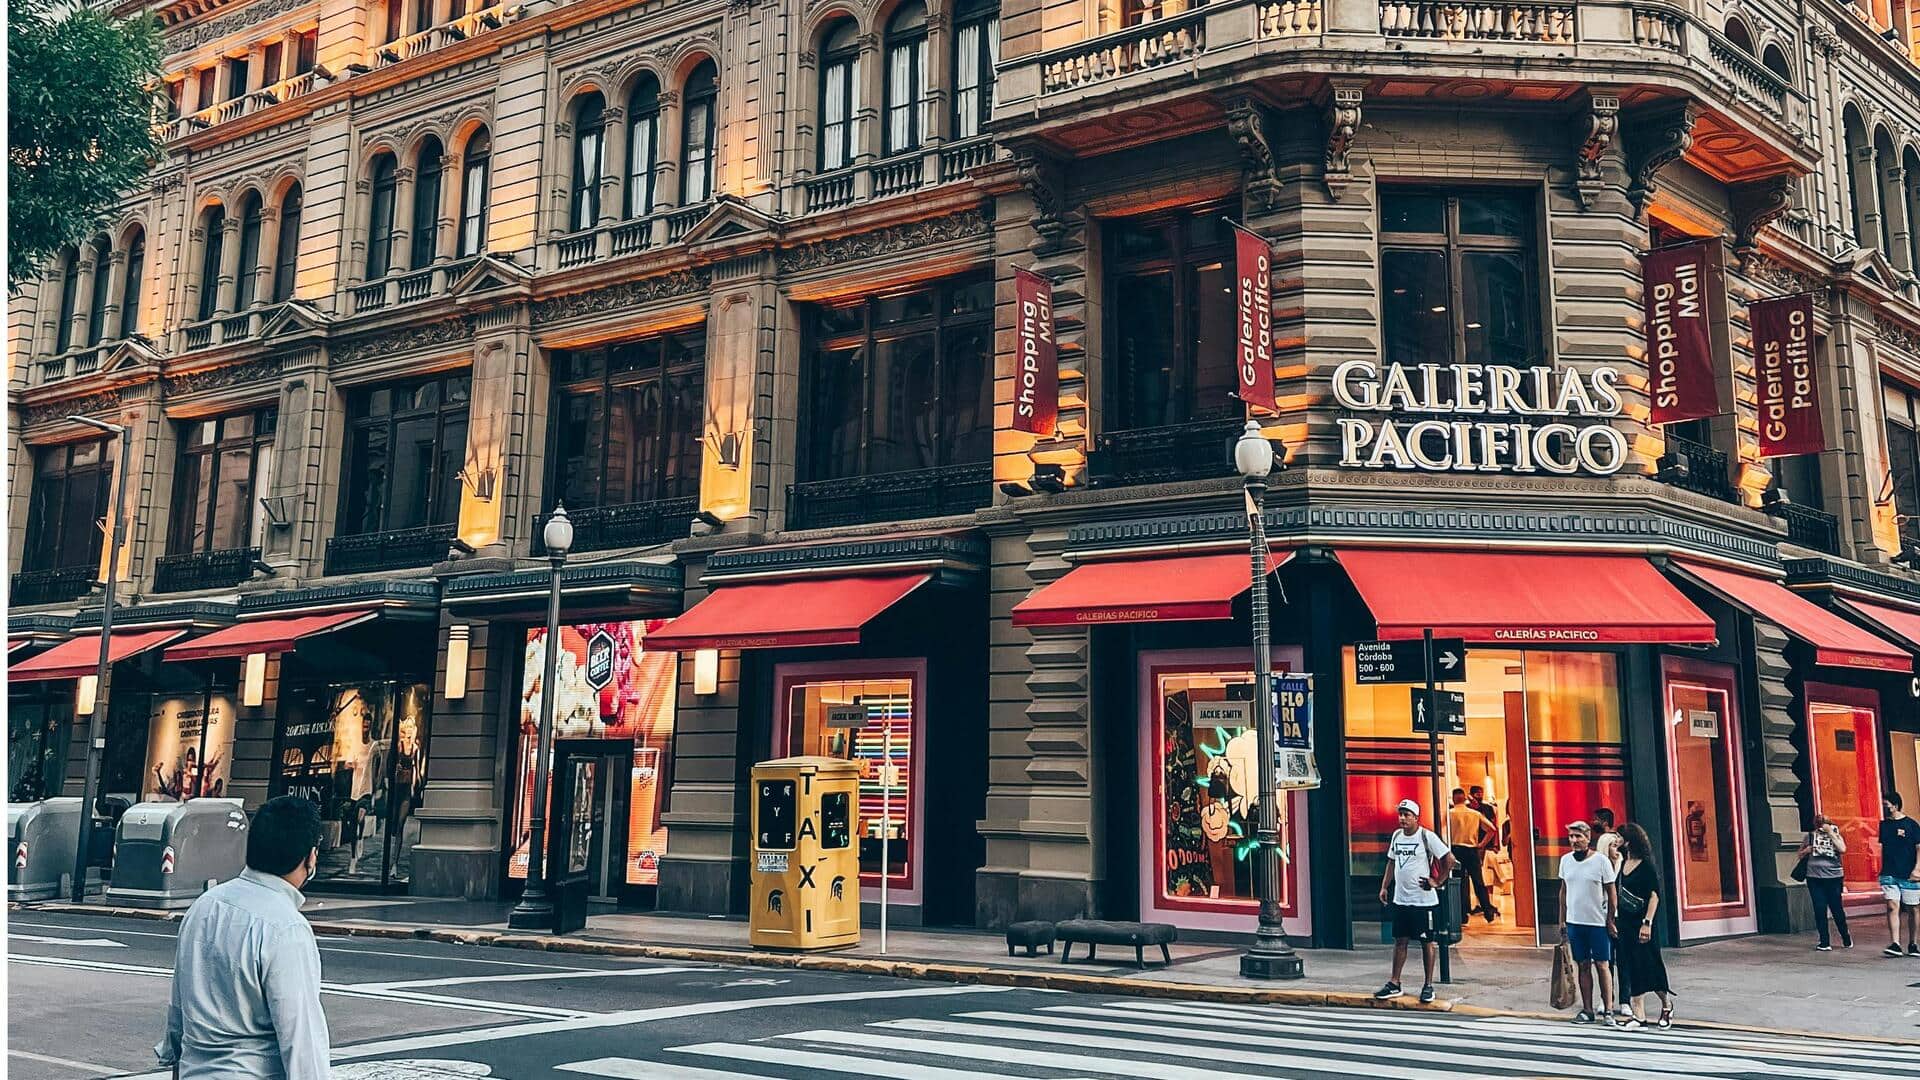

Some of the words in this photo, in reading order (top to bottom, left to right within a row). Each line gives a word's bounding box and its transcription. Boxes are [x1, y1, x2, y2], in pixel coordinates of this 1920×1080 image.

[1675, 263, 1701, 318] Mall
[1255, 255, 1270, 361] Pacífico
[1036, 292, 1052, 344] Mall
[1240, 277, 1256, 386] Galerías
[1651, 283, 1679, 408] Shopping
[1019, 301, 1040, 418] Shopping
[1786, 310, 1812, 409] Pacífico
[1332, 360, 1625, 417] GALERIAS
[1761, 341, 1788, 442] Galerías
[1335, 418, 1628, 474] PACIFICO
[1495, 628, 1546, 639] GALERÍAS
[1549, 630, 1598, 640] PACIFICO
[1358, 642, 1391, 651] Avenida
[590, 646, 610, 669] BEER
[1358, 652, 1393, 661] Córdoba
[1359, 664, 1374, 672] 500
[1281, 682, 1305, 692] CALLE
[1281, 692, 1304, 707] FLO
[1200, 710, 1221, 719] JACKIE
[1222, 709, 1243, 719] SMITH
[1282, 707, 1295, 722] RI
[1283, 722, 1302, 738] DA
[763, 786, 770, 796] C
[773, 807, 781, 817] Y
[785, 832, 792, 843] F
